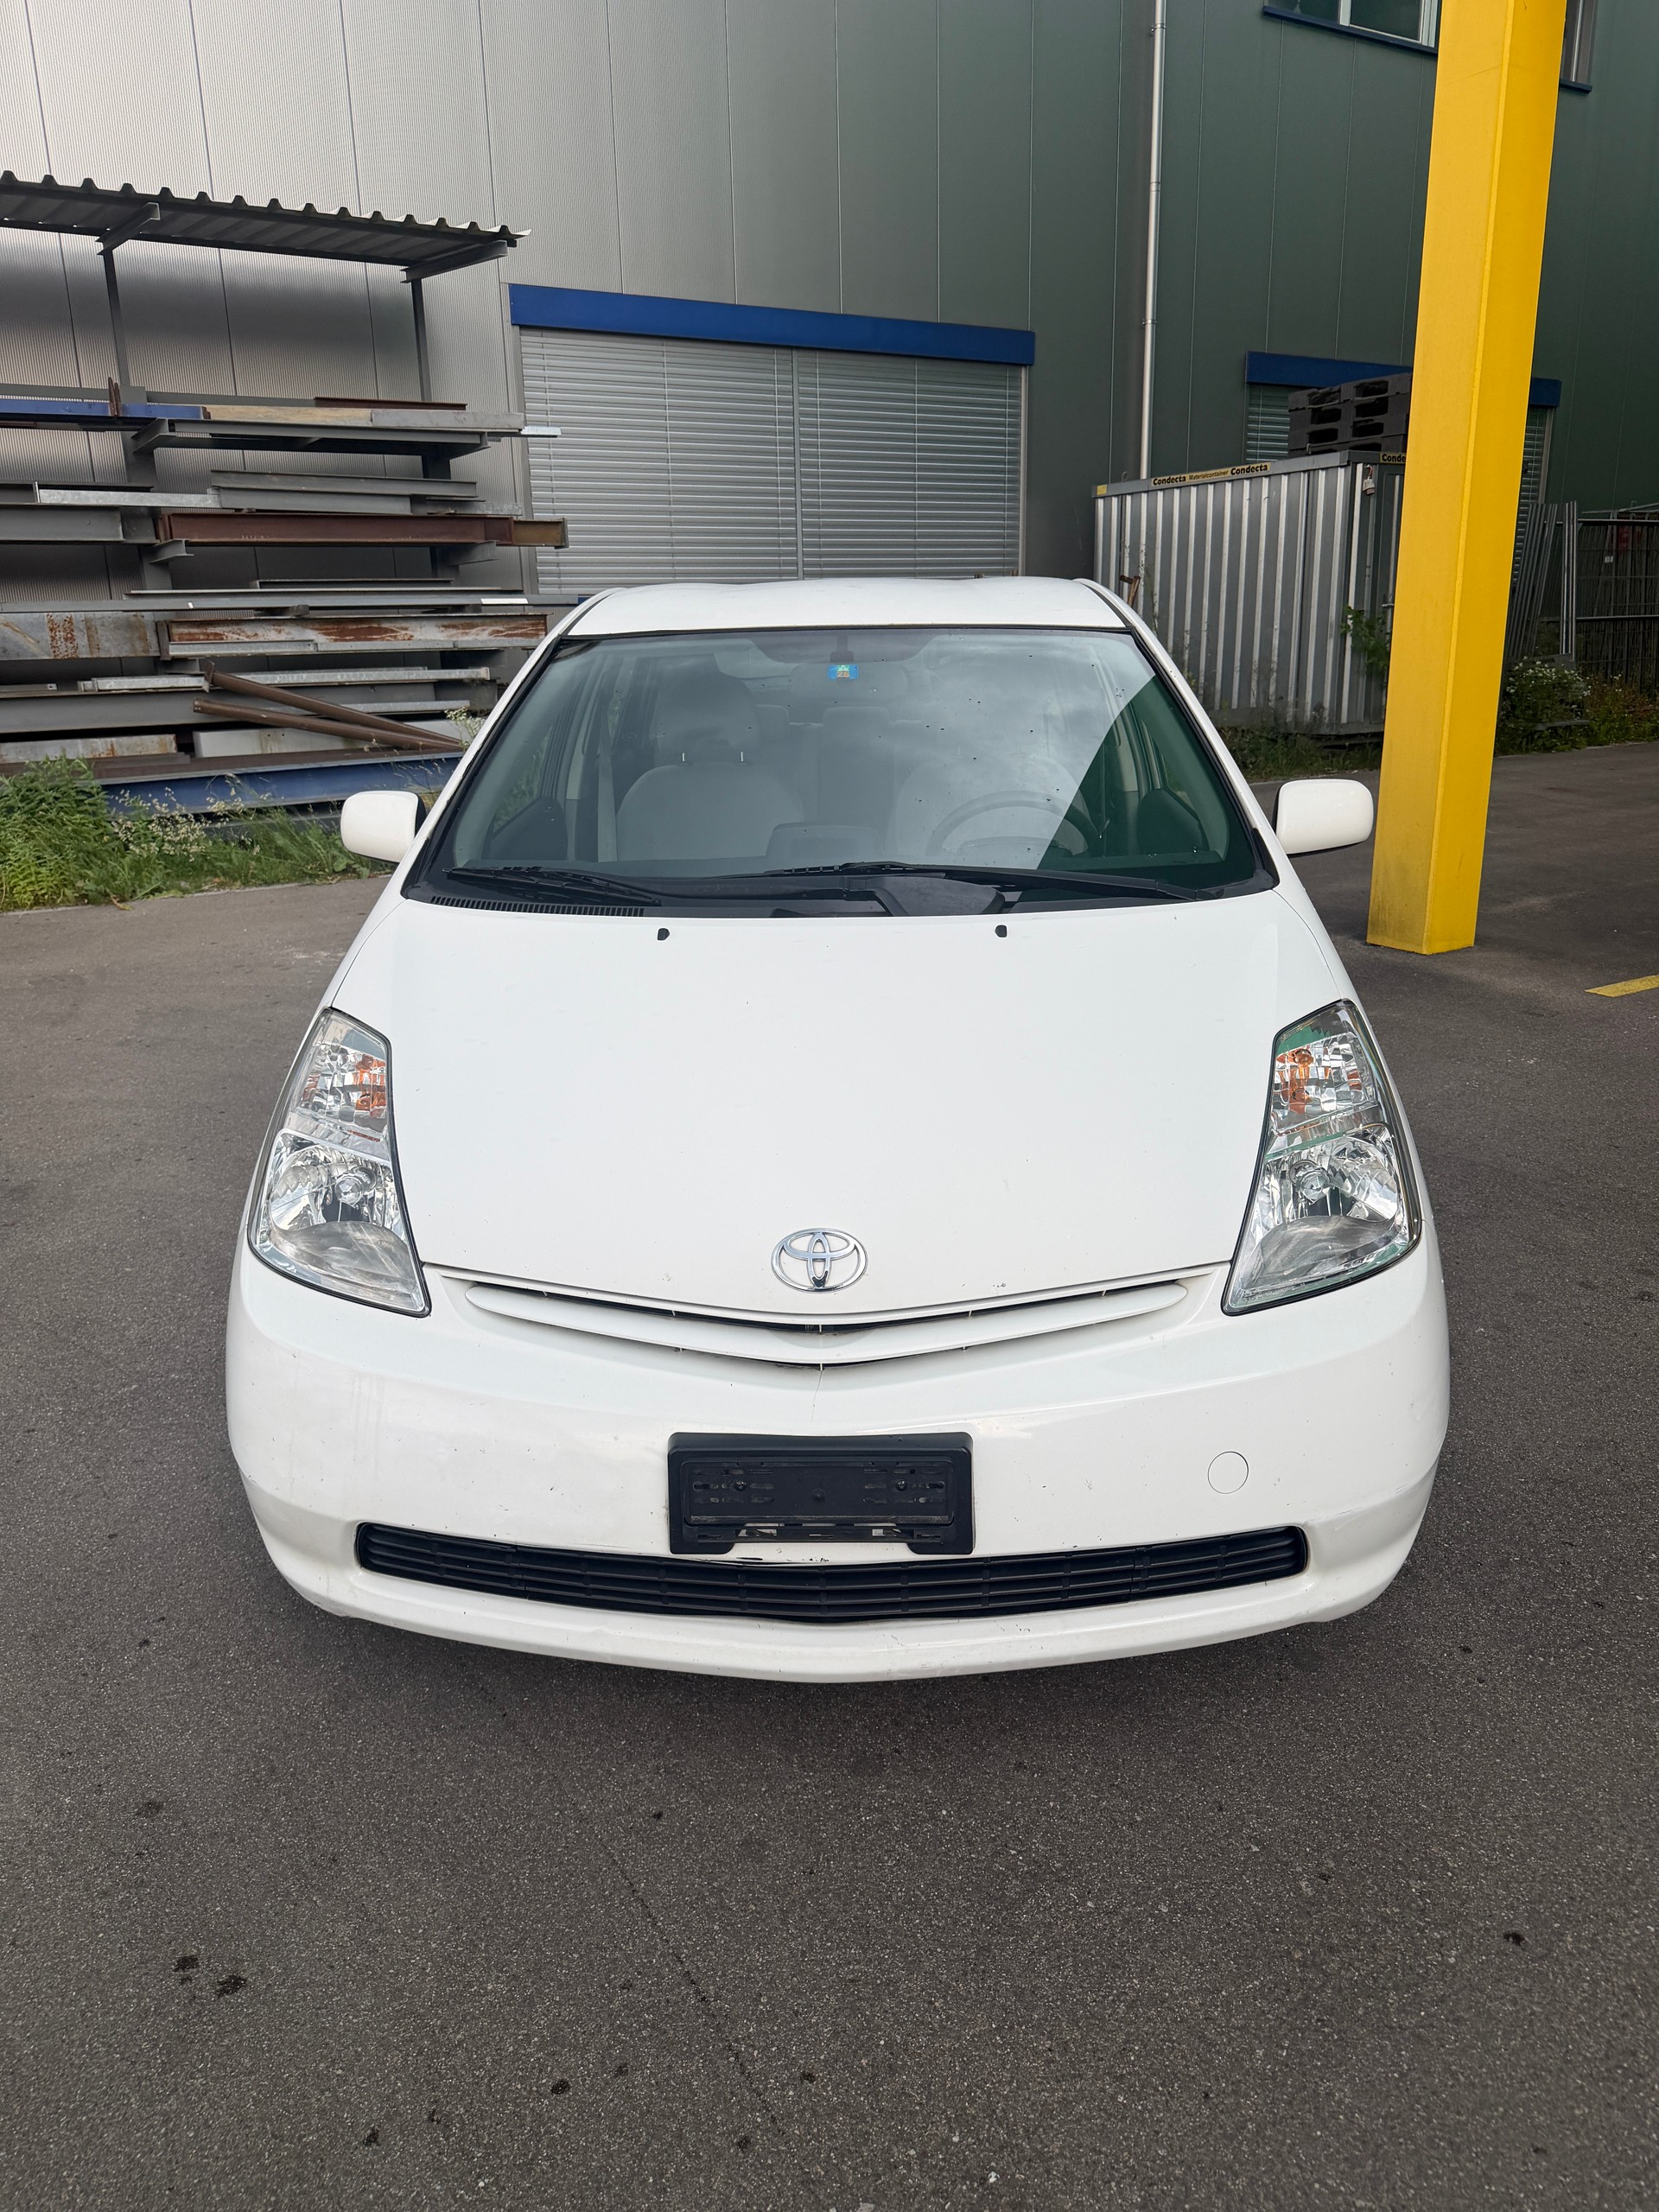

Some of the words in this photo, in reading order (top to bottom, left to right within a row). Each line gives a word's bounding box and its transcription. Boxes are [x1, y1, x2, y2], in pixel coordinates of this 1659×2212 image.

[1153, 475, 1186, 486] Condecta
[1189, 470, 1229, 480] Materialcontainer
[1230, 464, 1268, 476] Condecta
